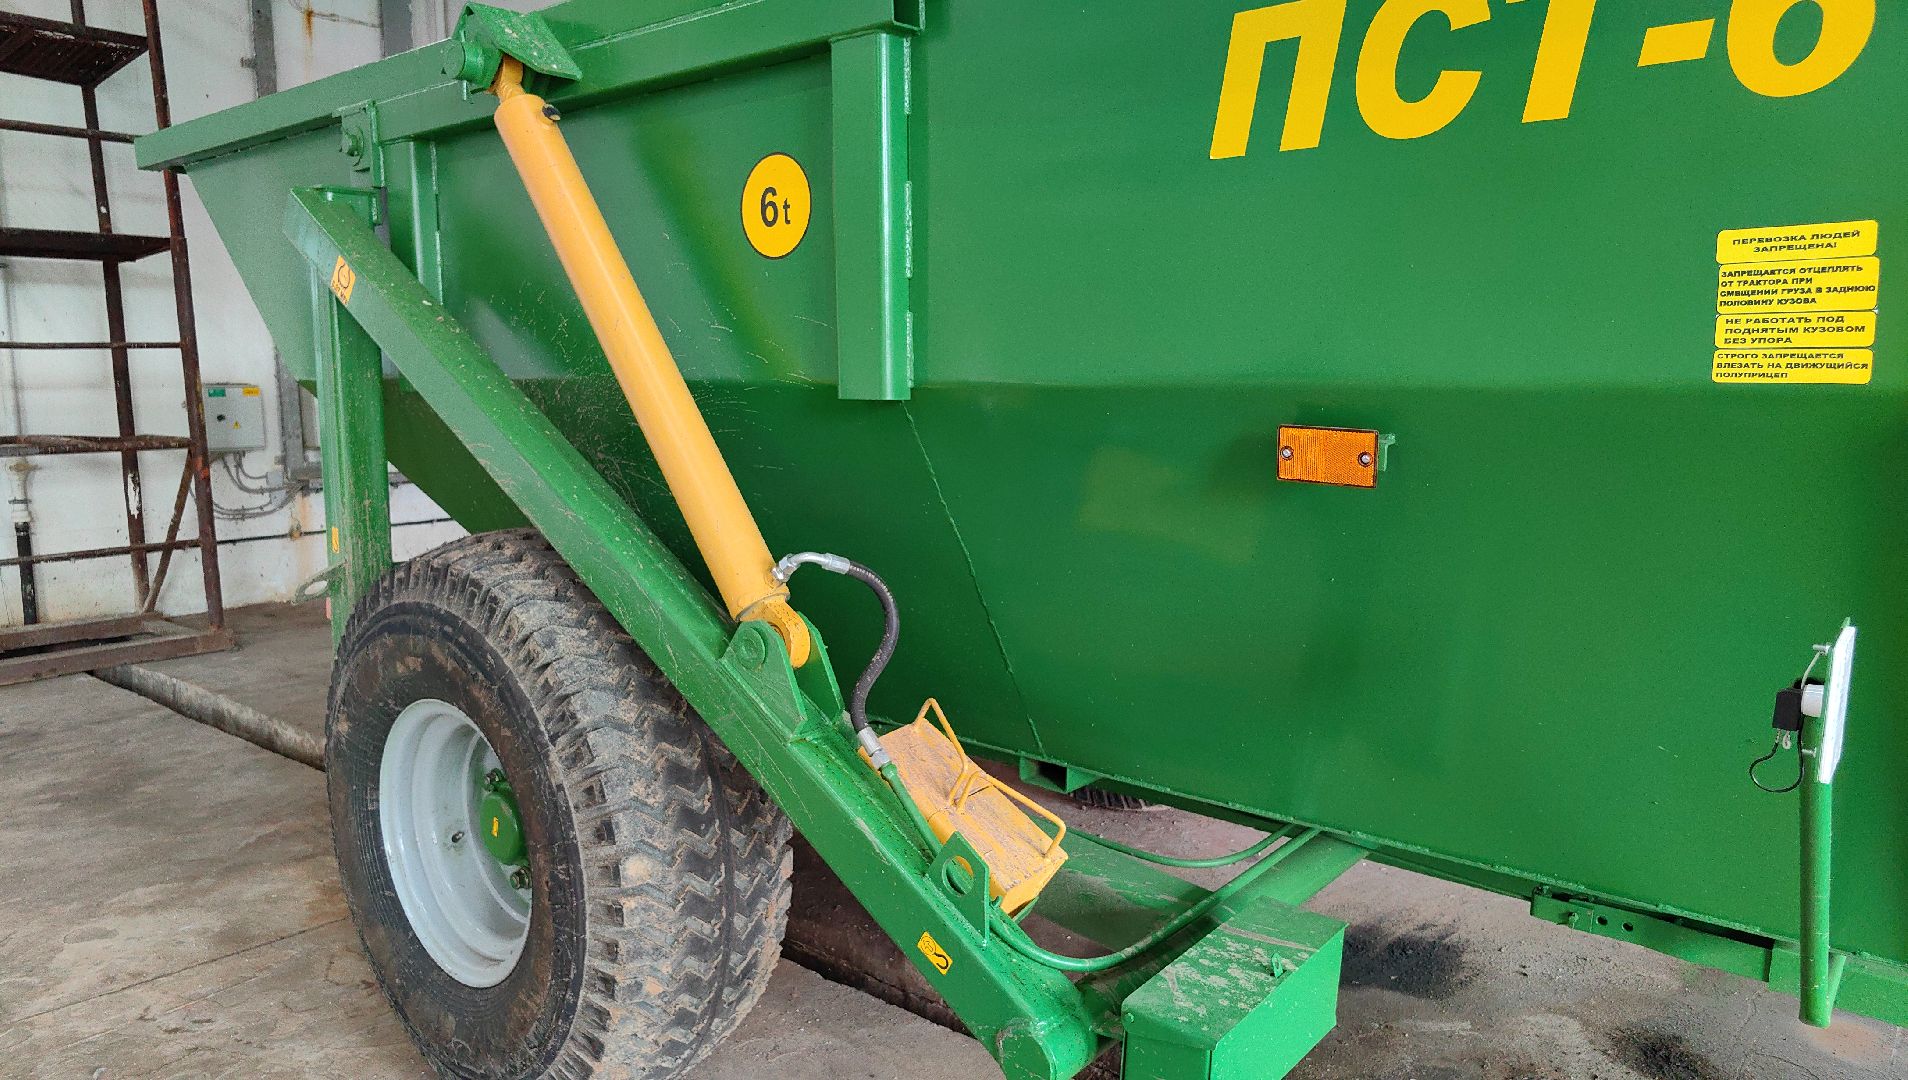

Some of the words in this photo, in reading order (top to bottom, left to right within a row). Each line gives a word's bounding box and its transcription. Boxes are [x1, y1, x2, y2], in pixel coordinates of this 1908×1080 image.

[1810, 230, 1860, 241] ЛЮДЕЙ
[1753, 242, 1837, 253] ЗАПРЕЩЕНА!
[1722, 268, 1796, 278] ЗАПРЕЩАЕТСЯ
[1737, 278, 1788, 287] ТРАКТОРА
[1826, 285, 1875, 294] ЗАДНЮЮ
[1777, 297, 1816, 305] КУЗОВА
[1746, 316, 1812, 324] РАБОТАТЬ
[1816, 316, 1845, 324] ПОД
[1724, 327, 1799, 335] ПОДНЯТЫМ
[1785, 361, 1868, 370] ДВИЖУЩИЙСЯ
